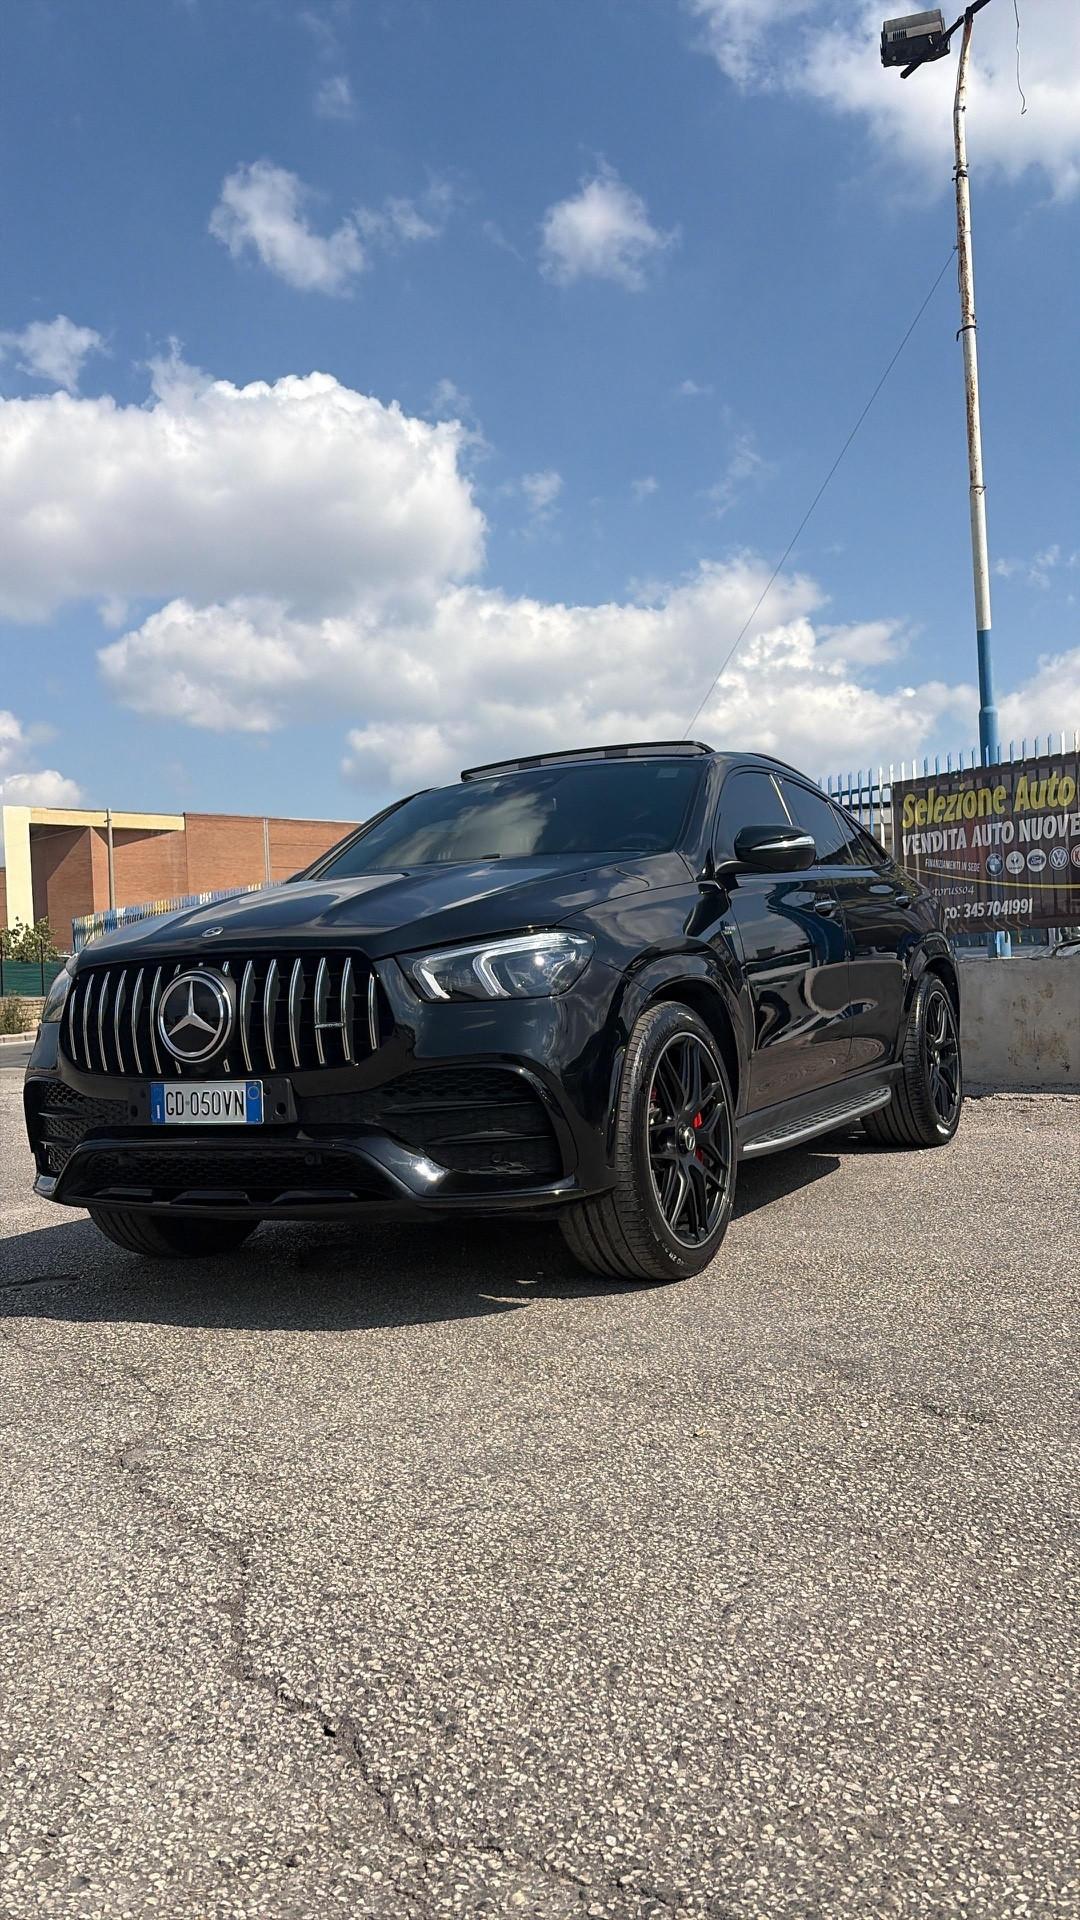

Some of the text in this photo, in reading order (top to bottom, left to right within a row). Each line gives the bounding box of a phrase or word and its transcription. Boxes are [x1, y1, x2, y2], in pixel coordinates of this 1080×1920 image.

[902, 771, 1076, 829] Selezione Auto
[902, 827, 967, 856] VENDITA
[971, 820, 1015, 848] AUTO
[932, 885, 974, 897] torusso4
[963, 902, 985, 918] 345
[986, 897, 1033, 917] 7041991
